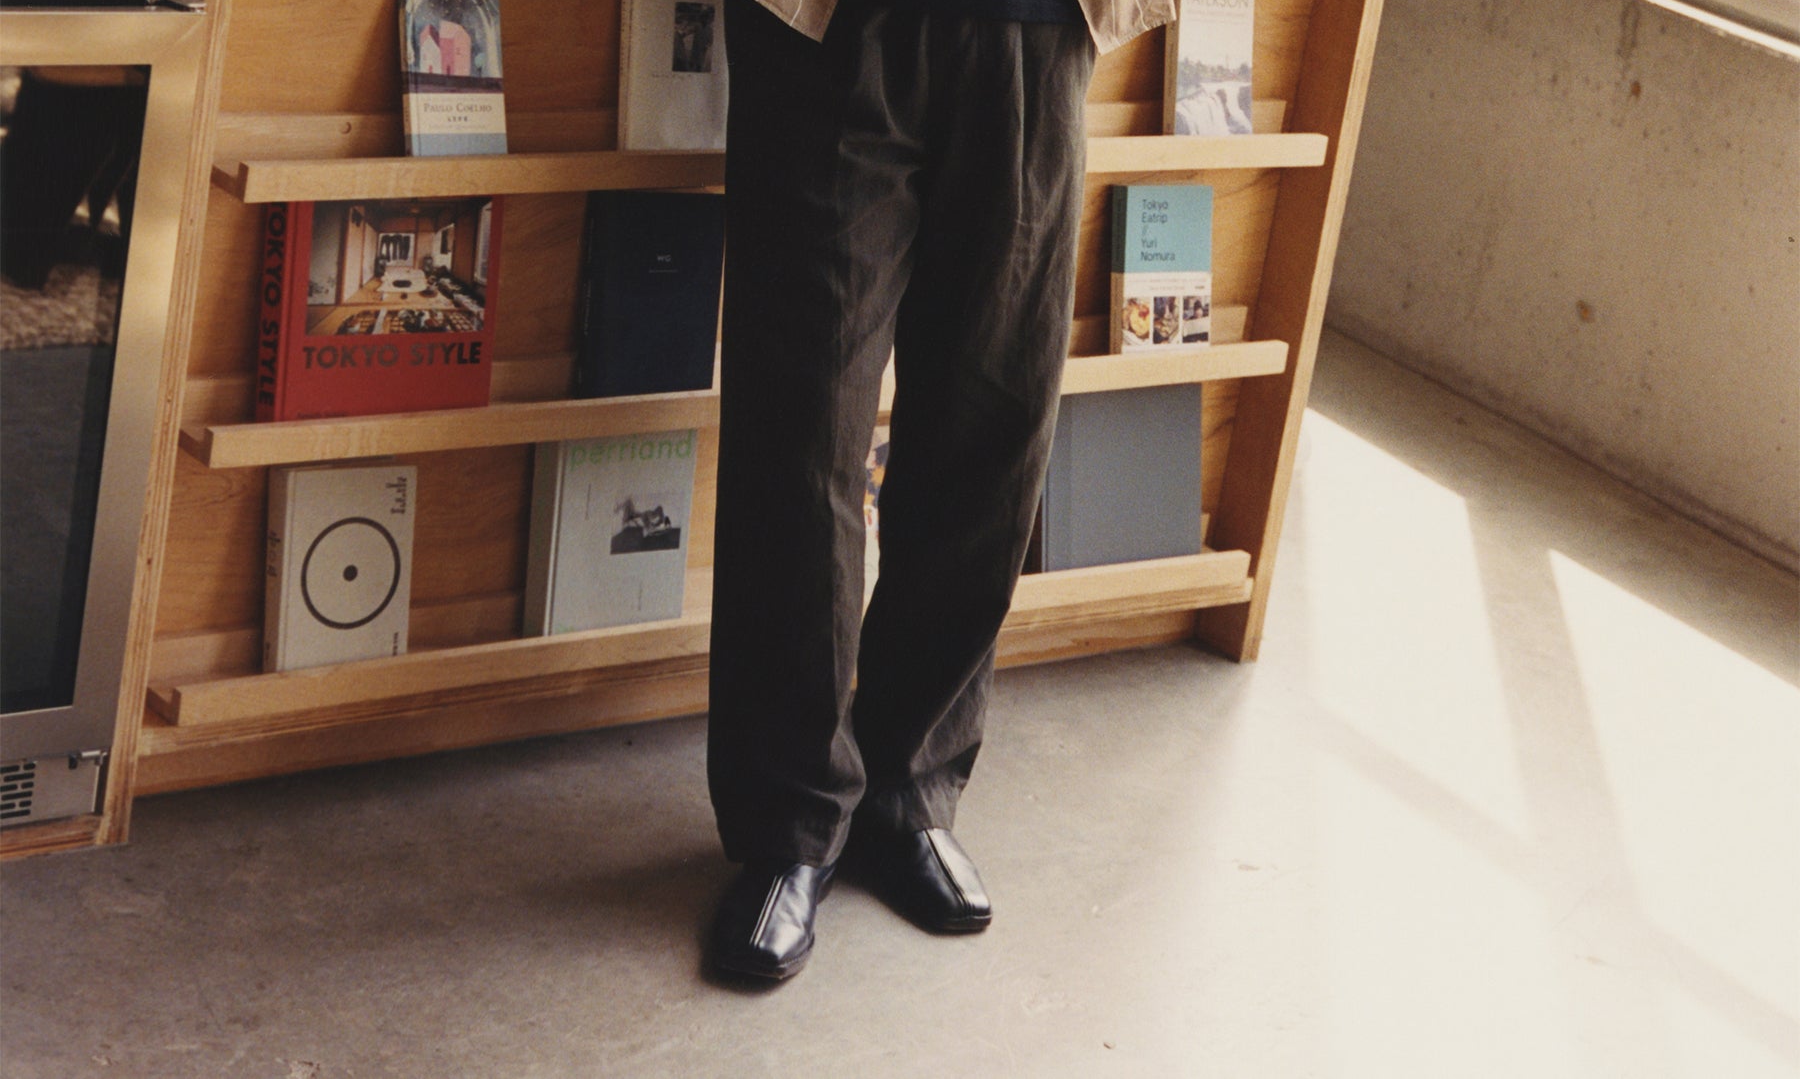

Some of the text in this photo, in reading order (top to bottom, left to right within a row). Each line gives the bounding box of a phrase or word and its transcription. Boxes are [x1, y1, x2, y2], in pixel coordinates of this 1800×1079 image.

[1142, 199, 1168, 211] Tokyo
[1141, 237, 1157, 249] Yuri
[1140, 251, 1176, 262] Nomura
[259, 319, 280, 406] STYLE
[302, 341, 483, 370] TOKYO STYLE
[571, 428, 694, 473] perriand
